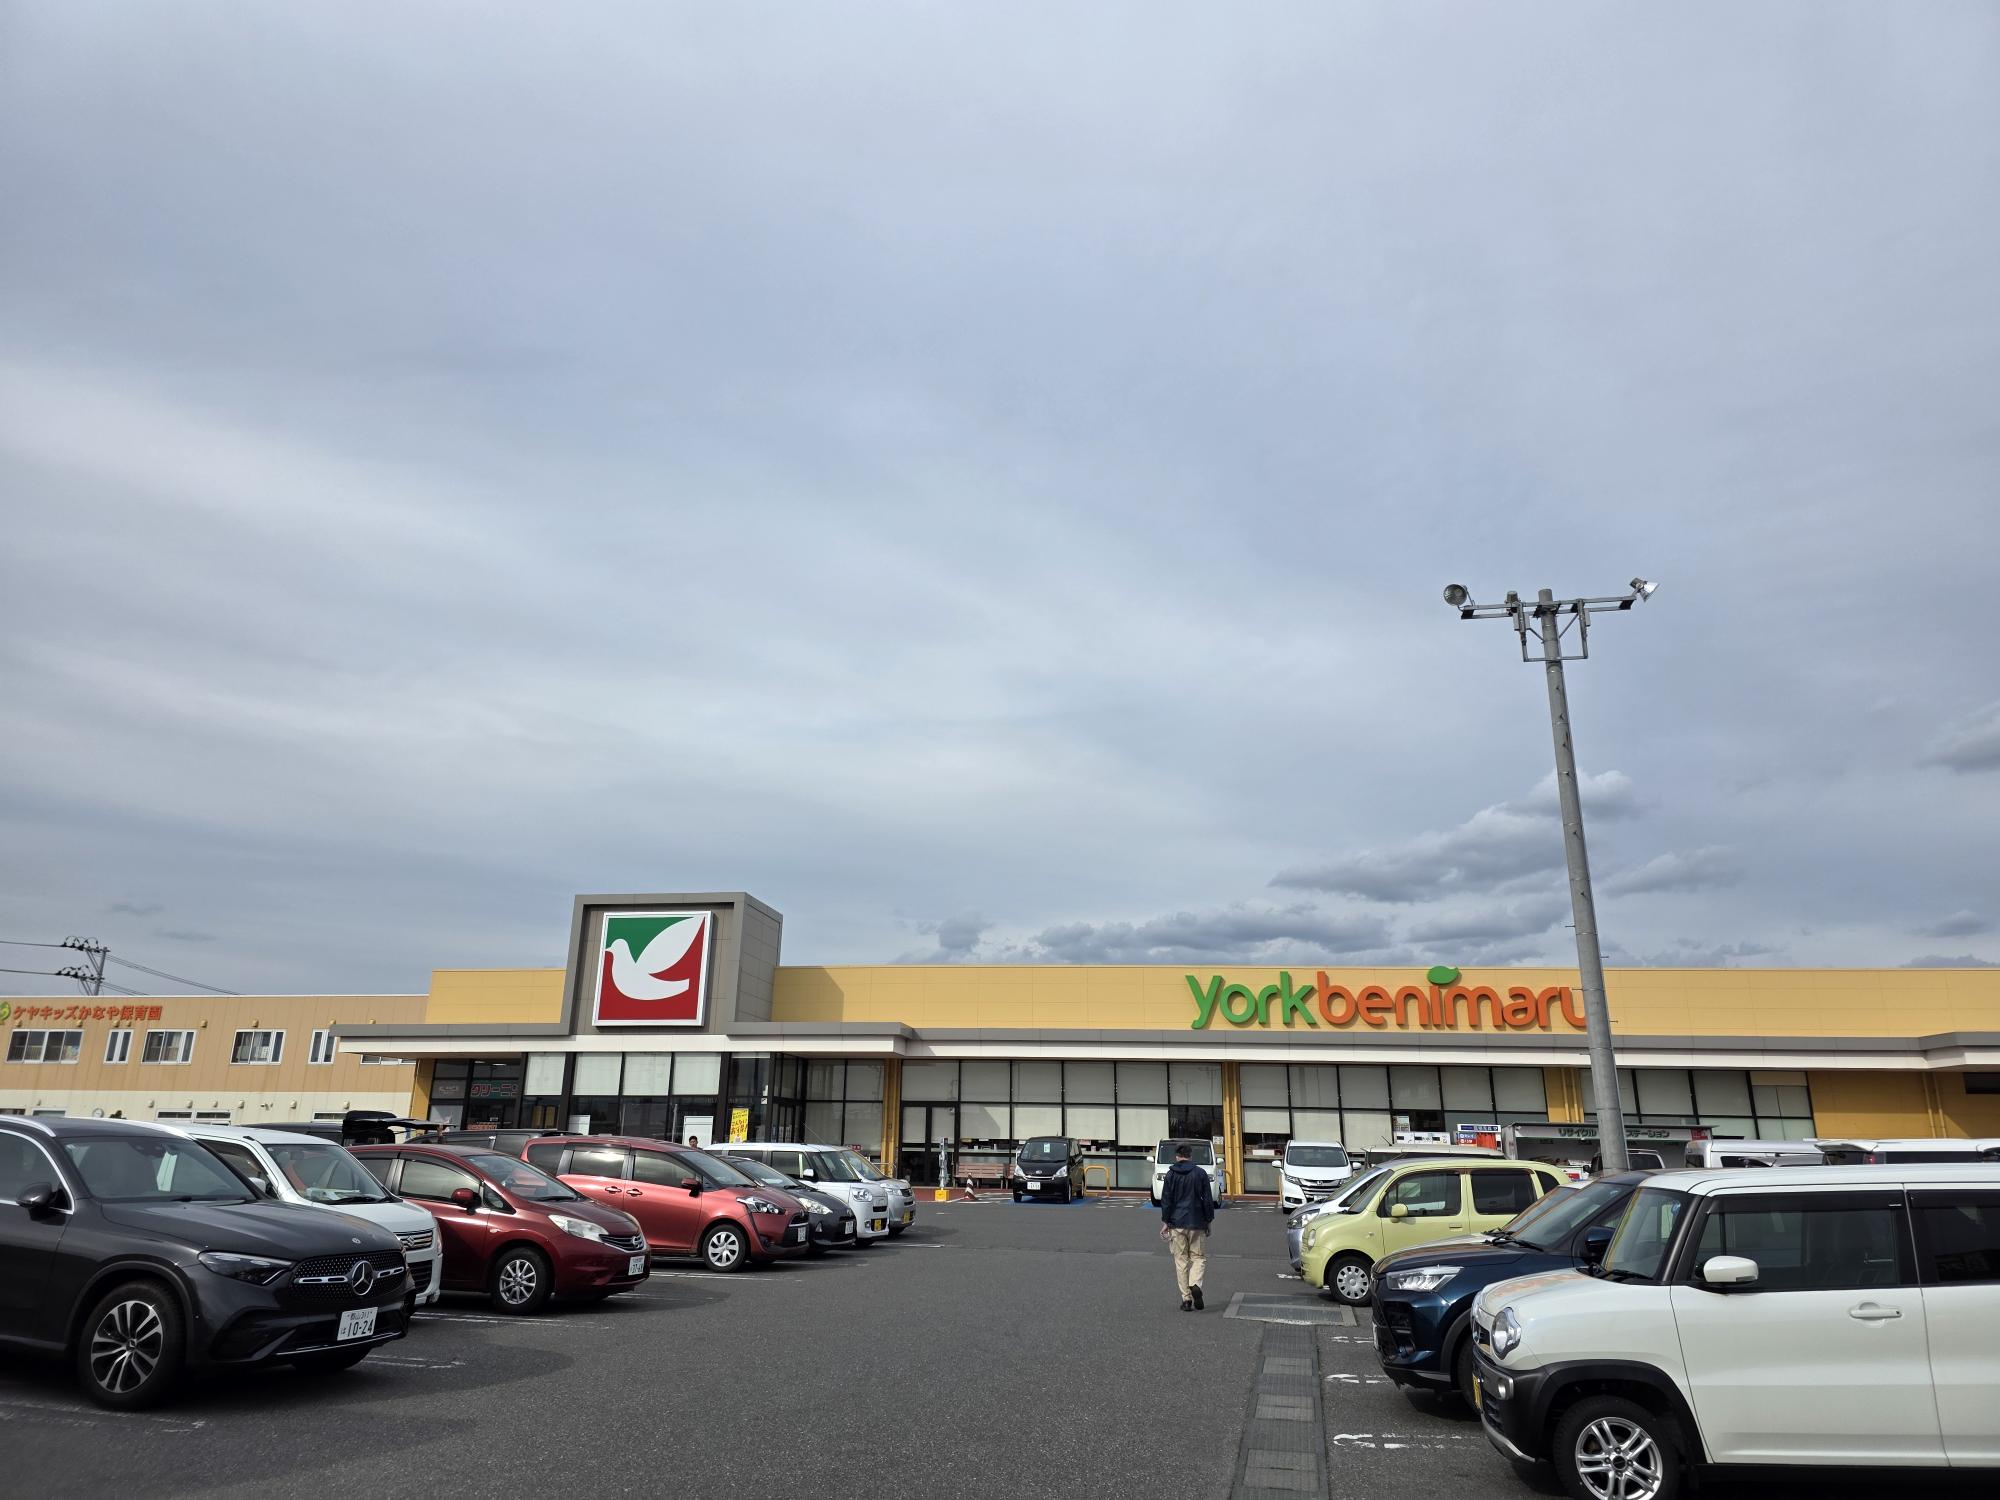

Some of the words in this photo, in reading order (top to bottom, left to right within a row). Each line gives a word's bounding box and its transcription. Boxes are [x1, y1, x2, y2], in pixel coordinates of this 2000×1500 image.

[13, 1005, 162, 1021] ケヤキッズかなや保育園
[1558, 1127, 1597, 1138] リサイクル
[1625, 1129, 1670, 1139] ステーション
[347, 1319, 374, 1337] 10-24
